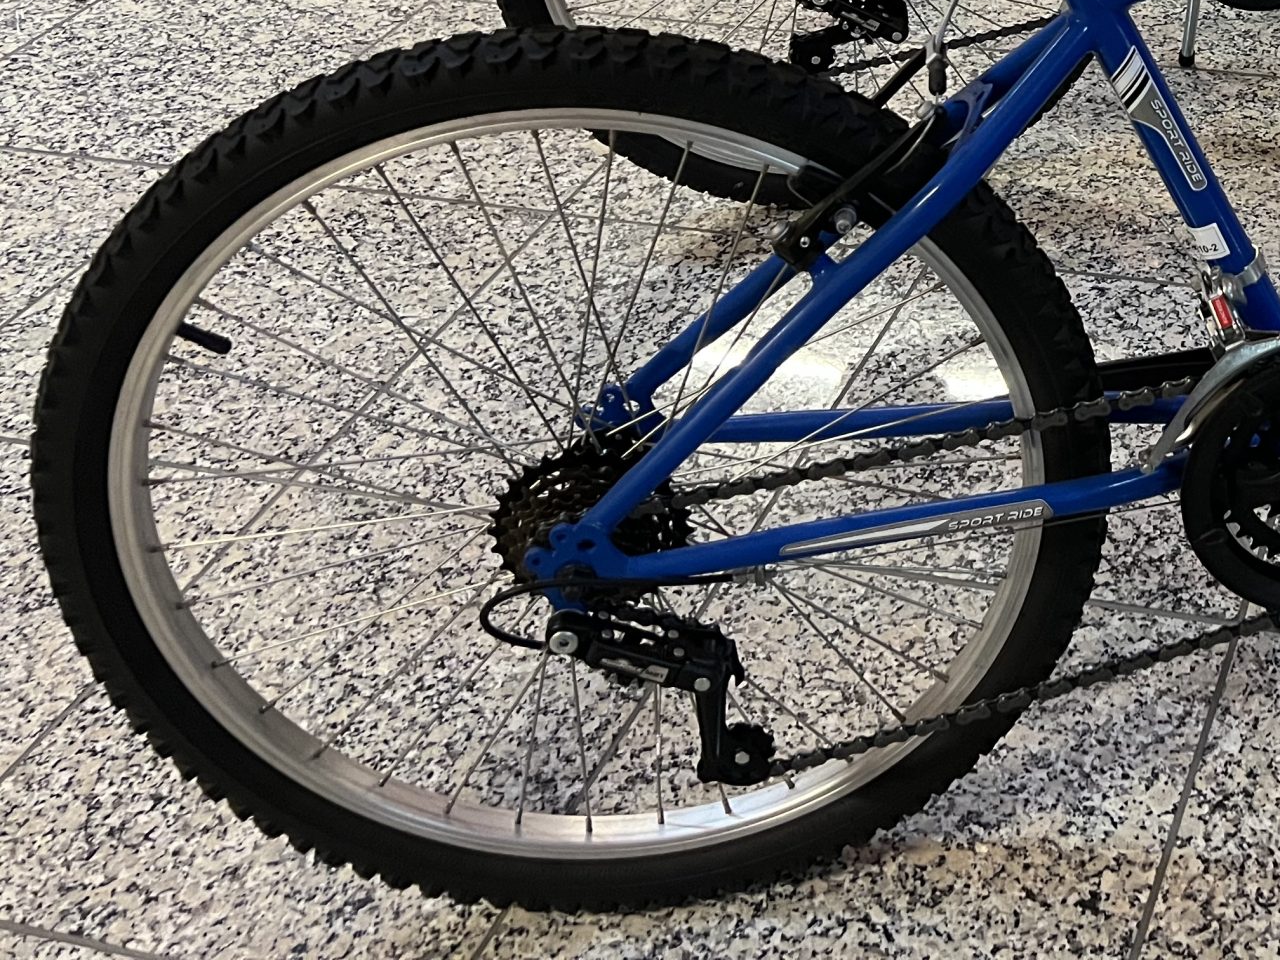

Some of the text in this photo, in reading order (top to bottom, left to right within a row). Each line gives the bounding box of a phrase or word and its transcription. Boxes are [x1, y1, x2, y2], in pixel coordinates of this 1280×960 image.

[1150, 100, 1203, 183] SPORT RIDE
[948, 506, 1044, 530] SPORT RIDE
